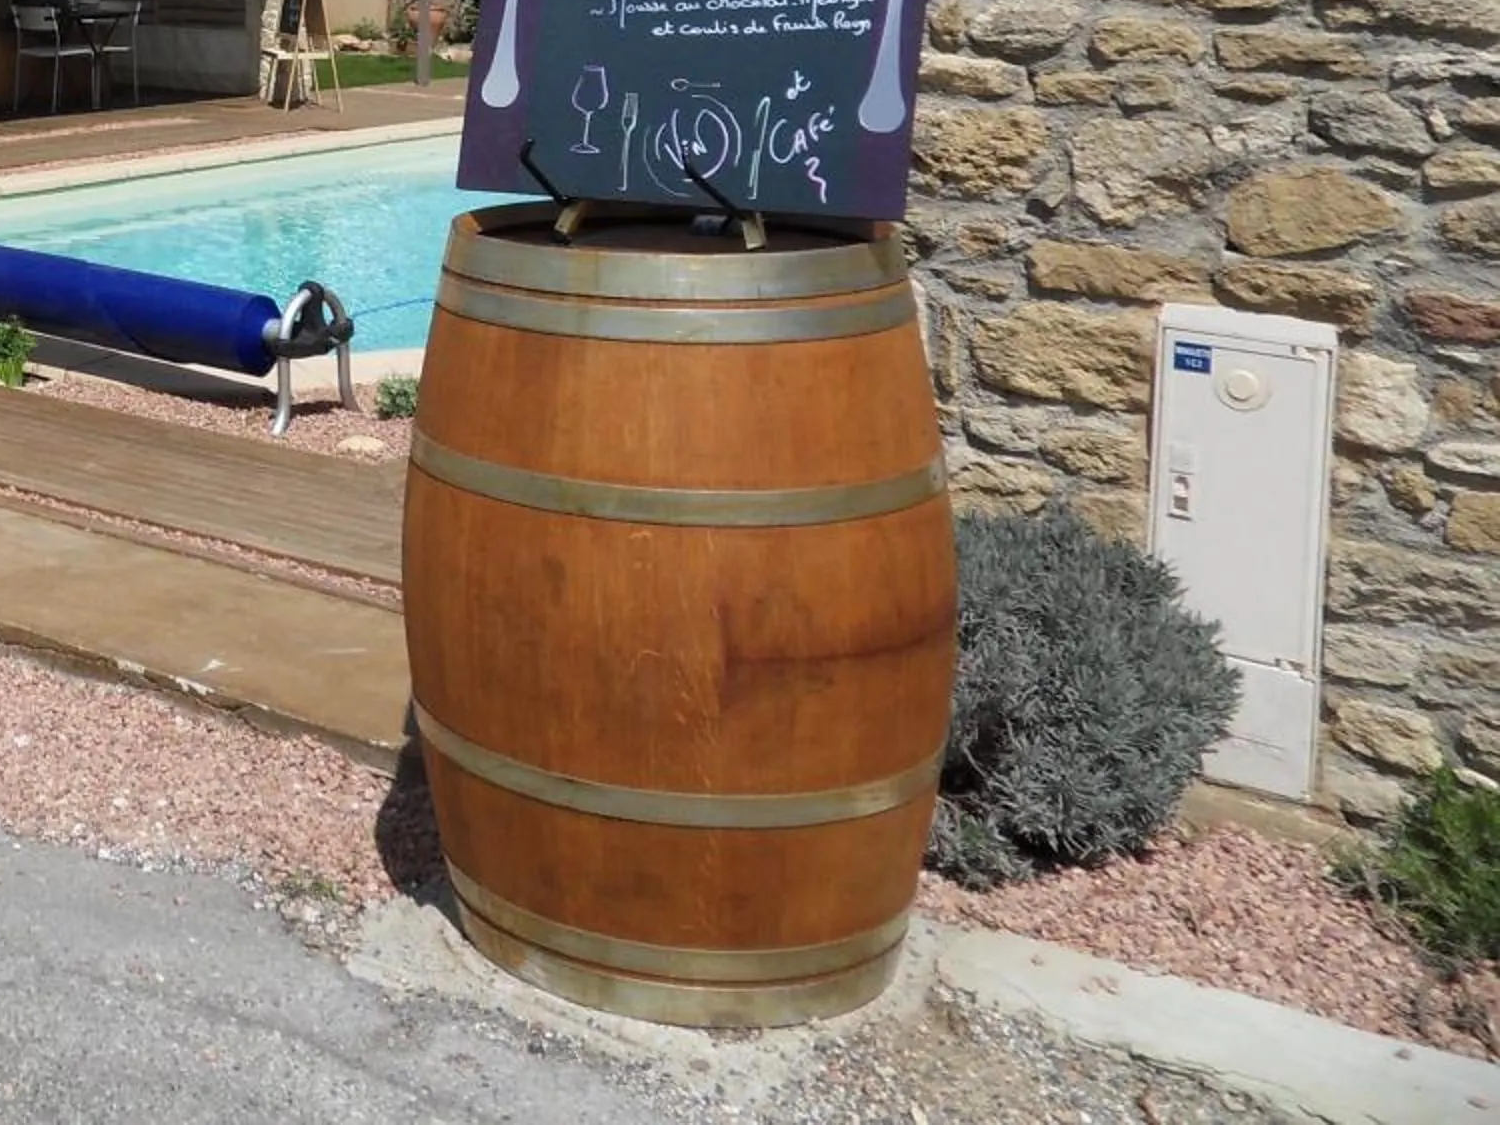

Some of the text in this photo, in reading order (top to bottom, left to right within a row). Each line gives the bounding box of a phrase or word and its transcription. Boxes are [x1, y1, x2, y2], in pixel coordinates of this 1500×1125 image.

[674, 1, 701, 12] au
[652, 19, 675, 36] et
[679, 18, 739, 35] coulis
[743, 19, 768, 35] de
[785, 70, 811, 100] et
